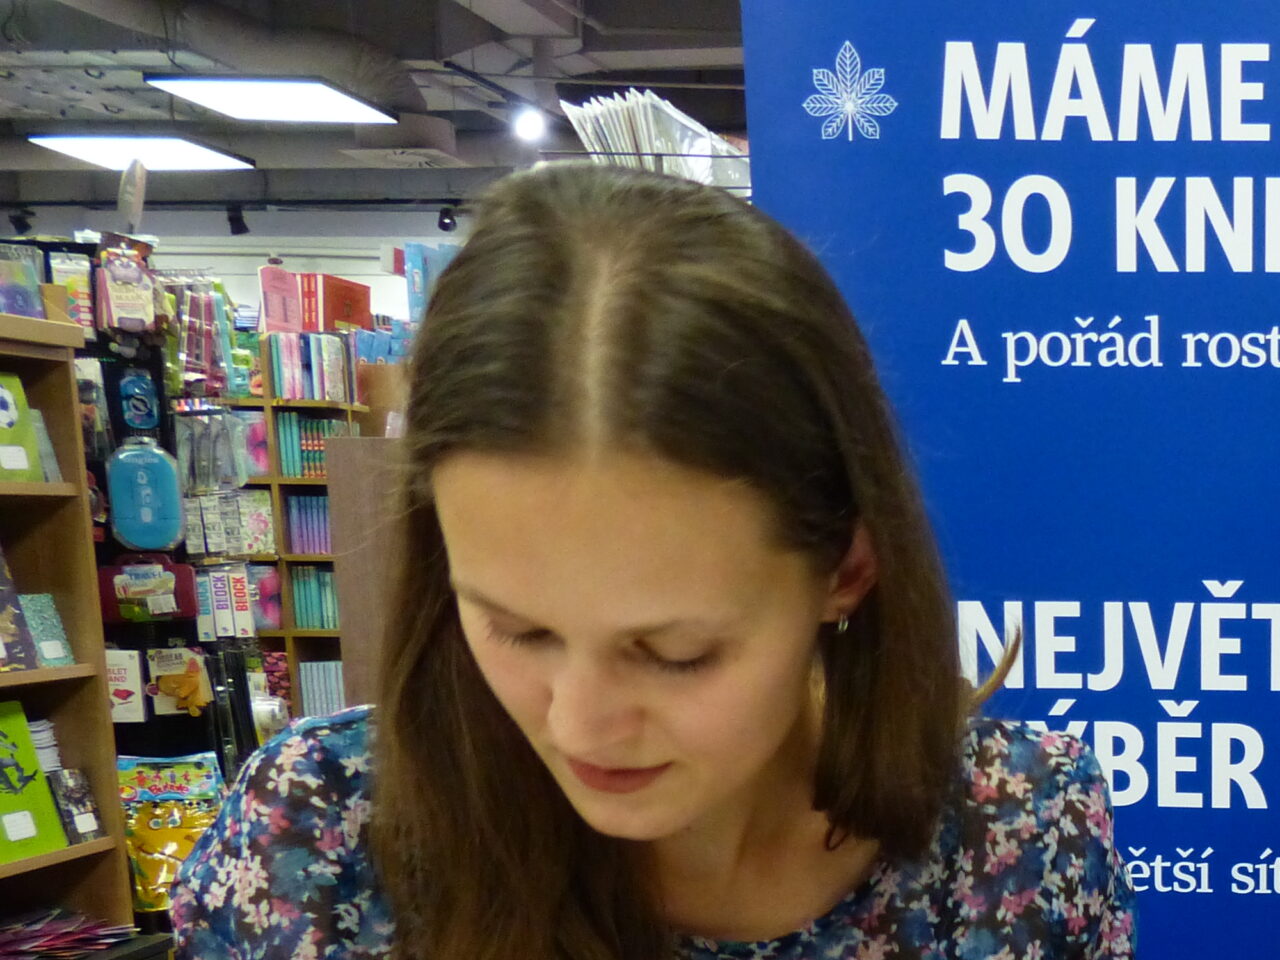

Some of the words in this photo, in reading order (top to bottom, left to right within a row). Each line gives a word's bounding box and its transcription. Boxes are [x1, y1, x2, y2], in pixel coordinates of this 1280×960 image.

[939, 18, 1271, 143] MÁME
[941, 173, 1073, 274] 30
[941, 318, 987, 367] A
[1001, 315, 1163, 384] pořád
[213, 575, 230, 610] BLOCK
[230, 576, 249, 612] BLOCK
[1026, 699, 1268, 810] BĚR
[1129, 846, 1214, 894] ětší
